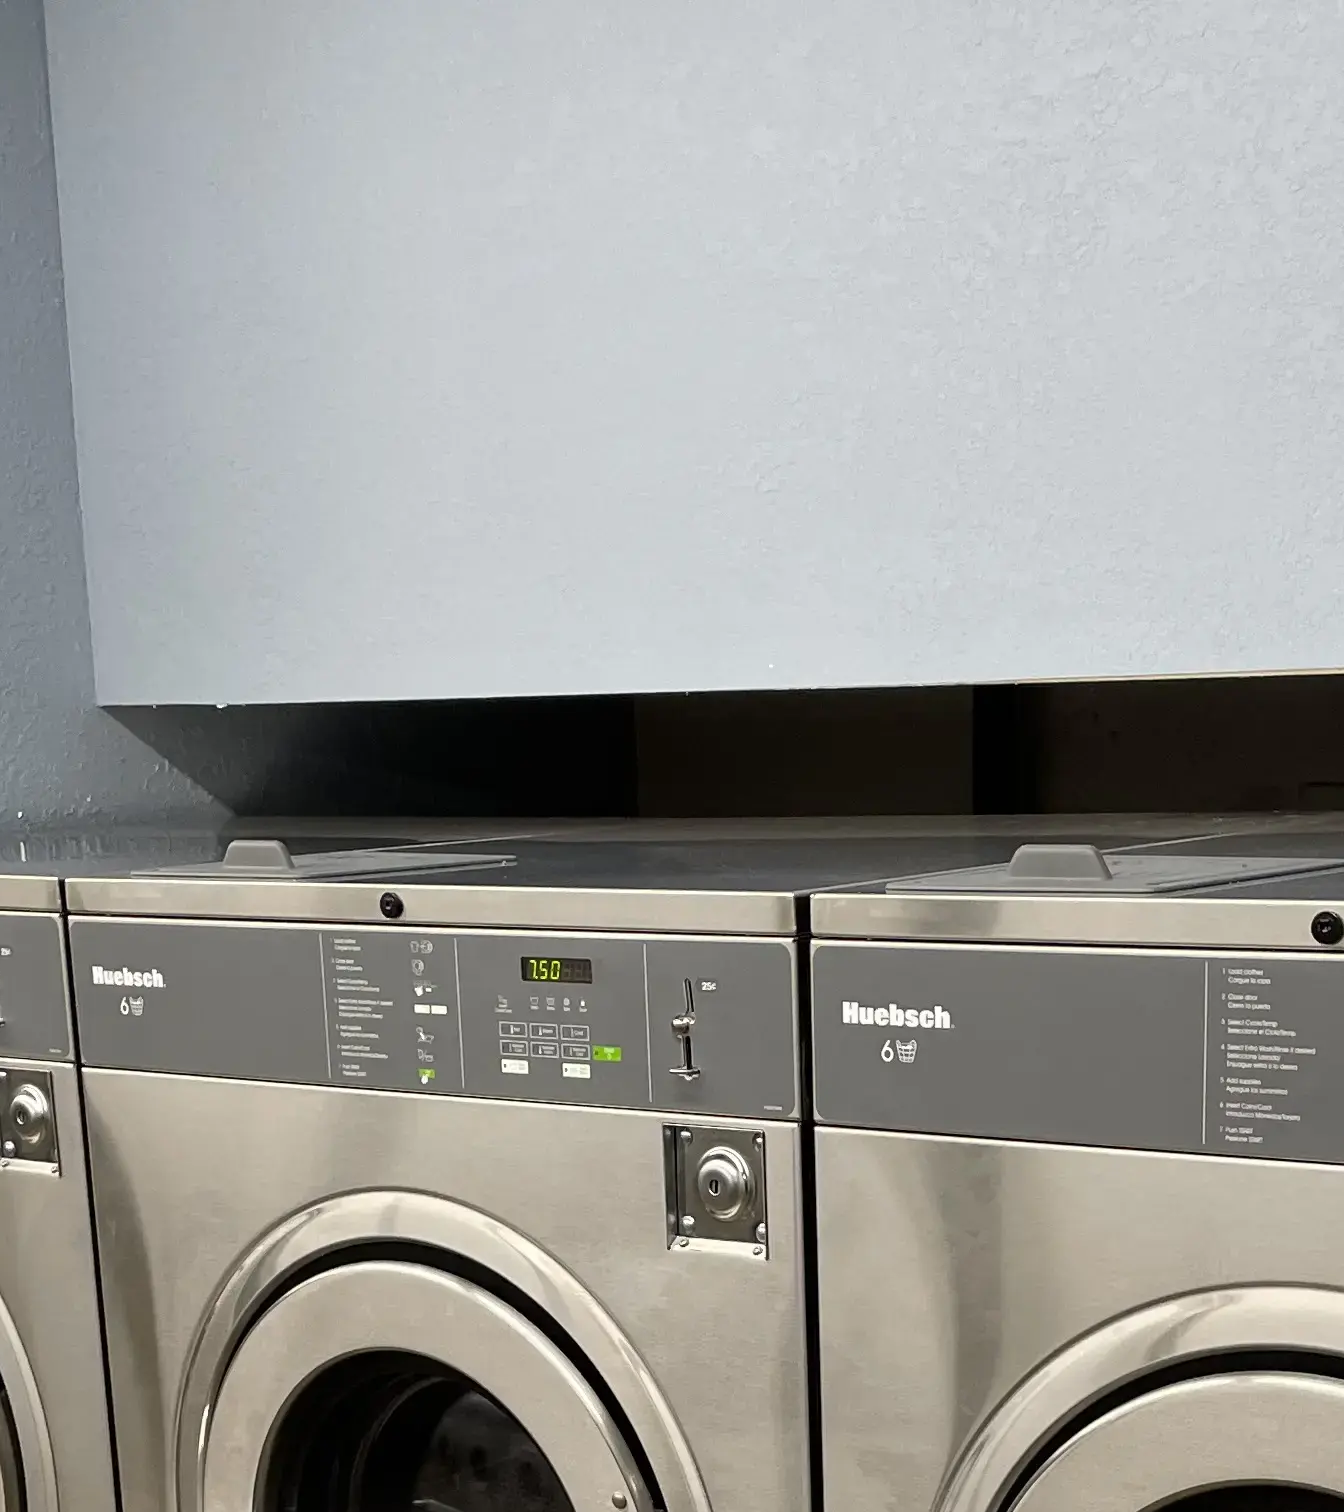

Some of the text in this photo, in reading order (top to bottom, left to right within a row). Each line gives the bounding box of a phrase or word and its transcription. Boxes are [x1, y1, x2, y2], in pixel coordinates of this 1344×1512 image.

[92, 965, 164, 988] Huebsch
[529, 959, 561, 980] 7.50
[120, 996, 129, 1015] 6
[842, 1001, 951, 1029] Huebsch
[881, 1039, 894, 1063] 6
